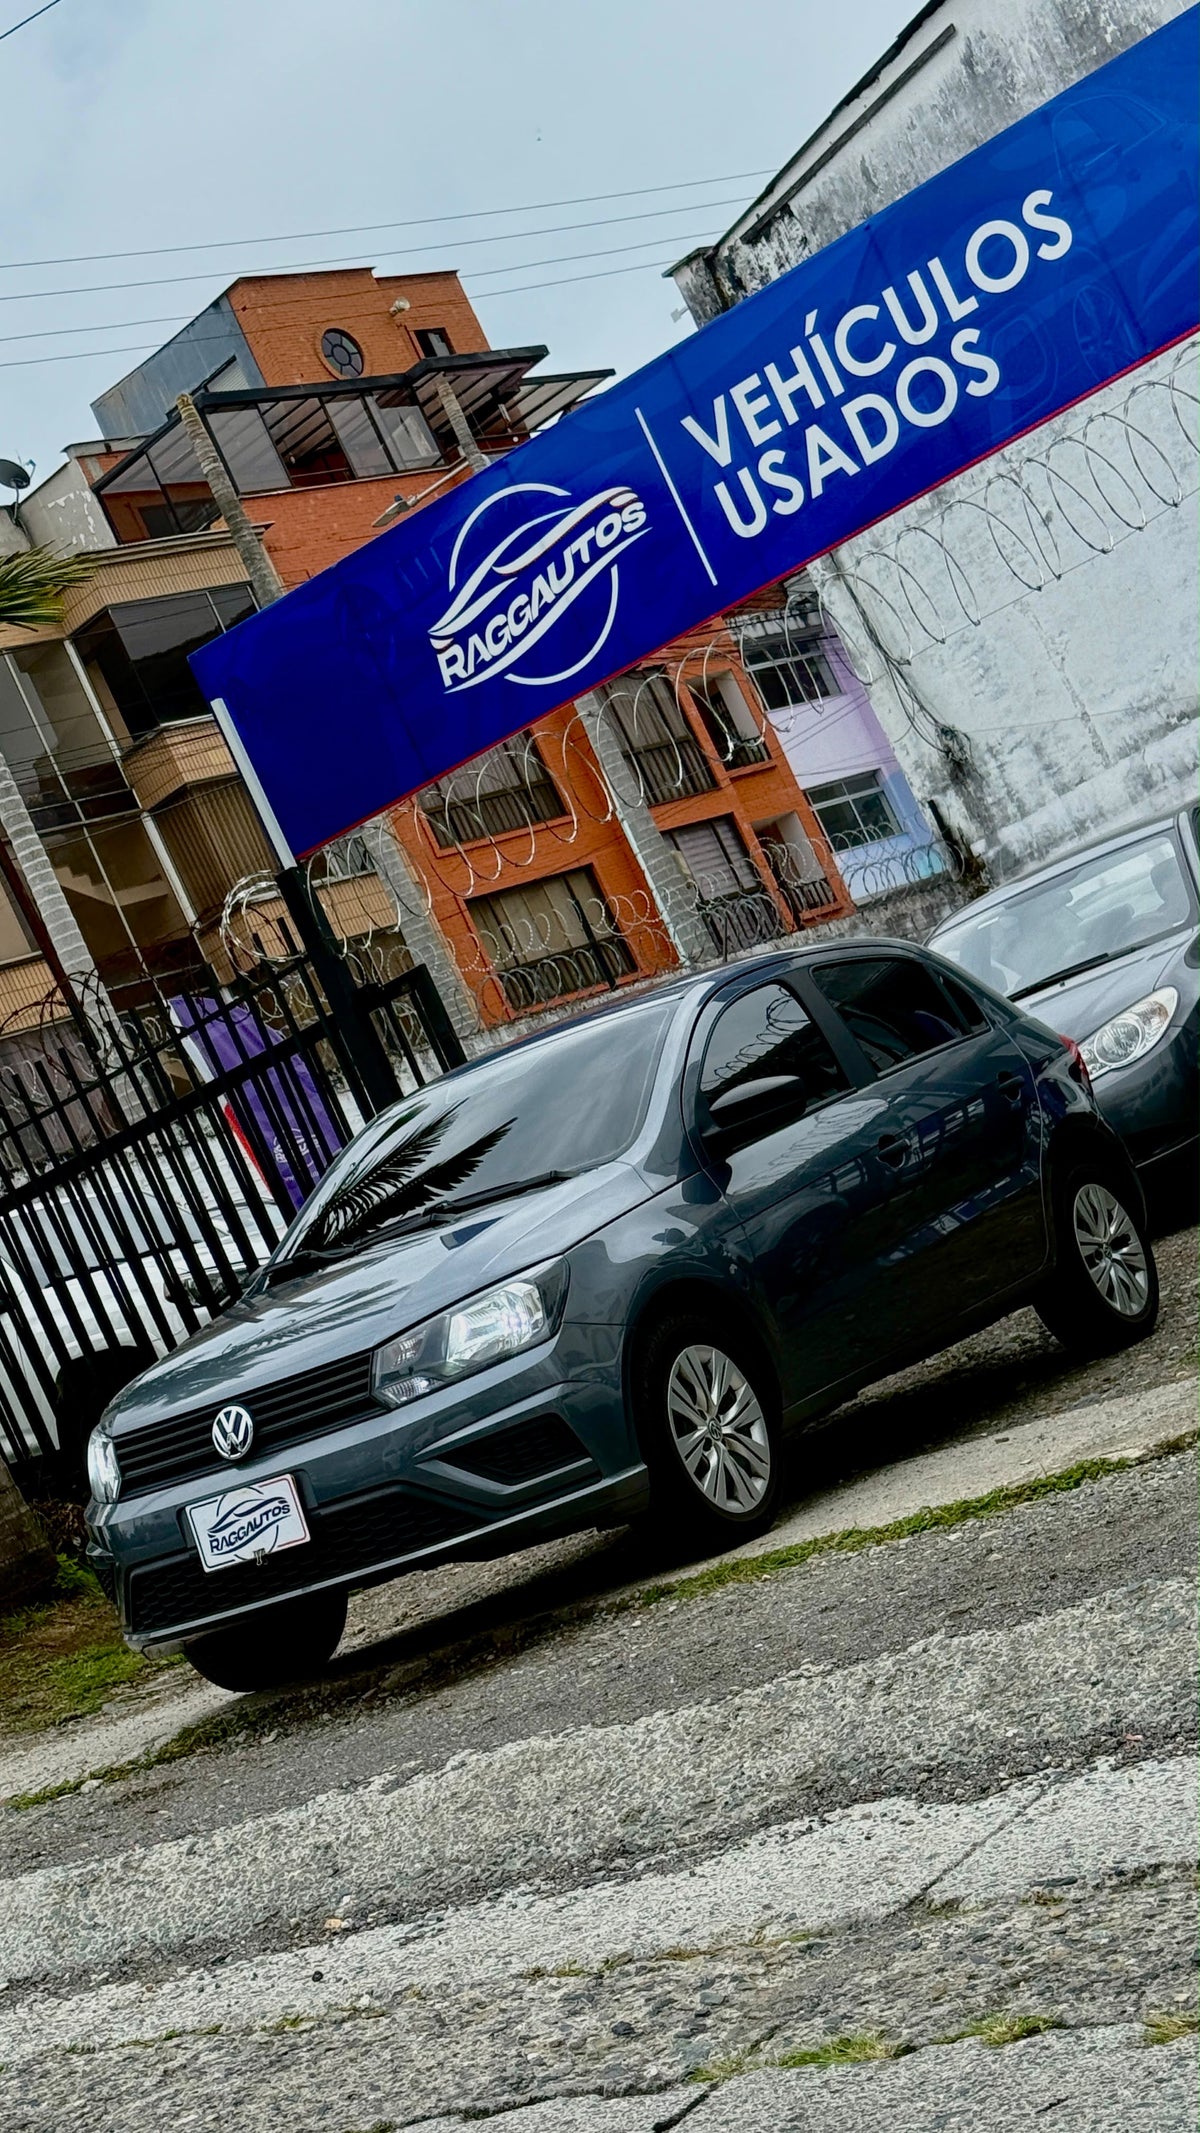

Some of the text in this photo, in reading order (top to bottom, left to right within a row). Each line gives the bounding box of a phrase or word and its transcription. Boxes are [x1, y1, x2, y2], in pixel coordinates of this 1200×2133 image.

[681, 190, 1073, 466] VEHÍCULOS
[714, 328, 1000, 538] USADOS
[438, 501, 648, 687] RAGGAUTOS
[212, 1405, 253, 1460] VW
[209, 1504, 291, 1553] RAGGAUTOS
